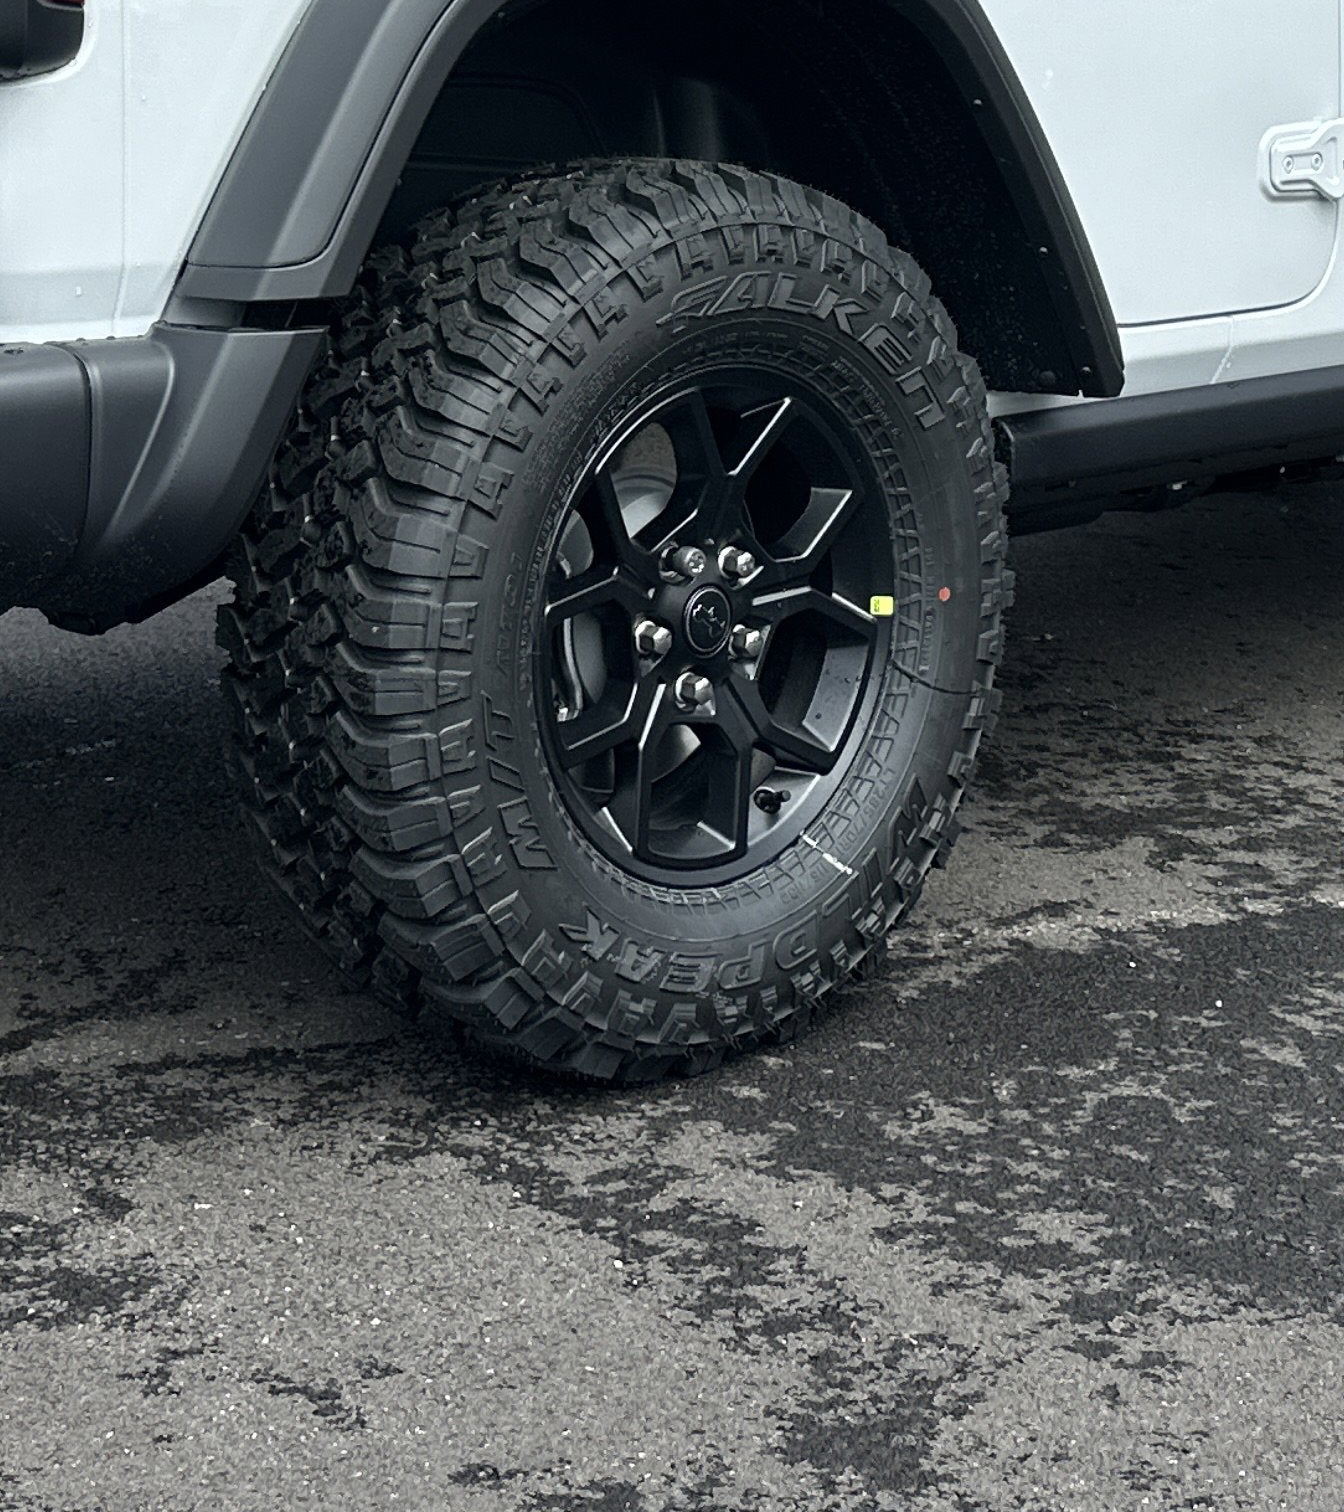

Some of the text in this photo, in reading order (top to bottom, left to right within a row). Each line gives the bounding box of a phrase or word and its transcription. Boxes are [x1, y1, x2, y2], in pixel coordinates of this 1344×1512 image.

[656, 270, 947, 430] FALKEN
[479, 689, 559, 871] M/T
[559, 775, 925, 995] WILDPEAK
